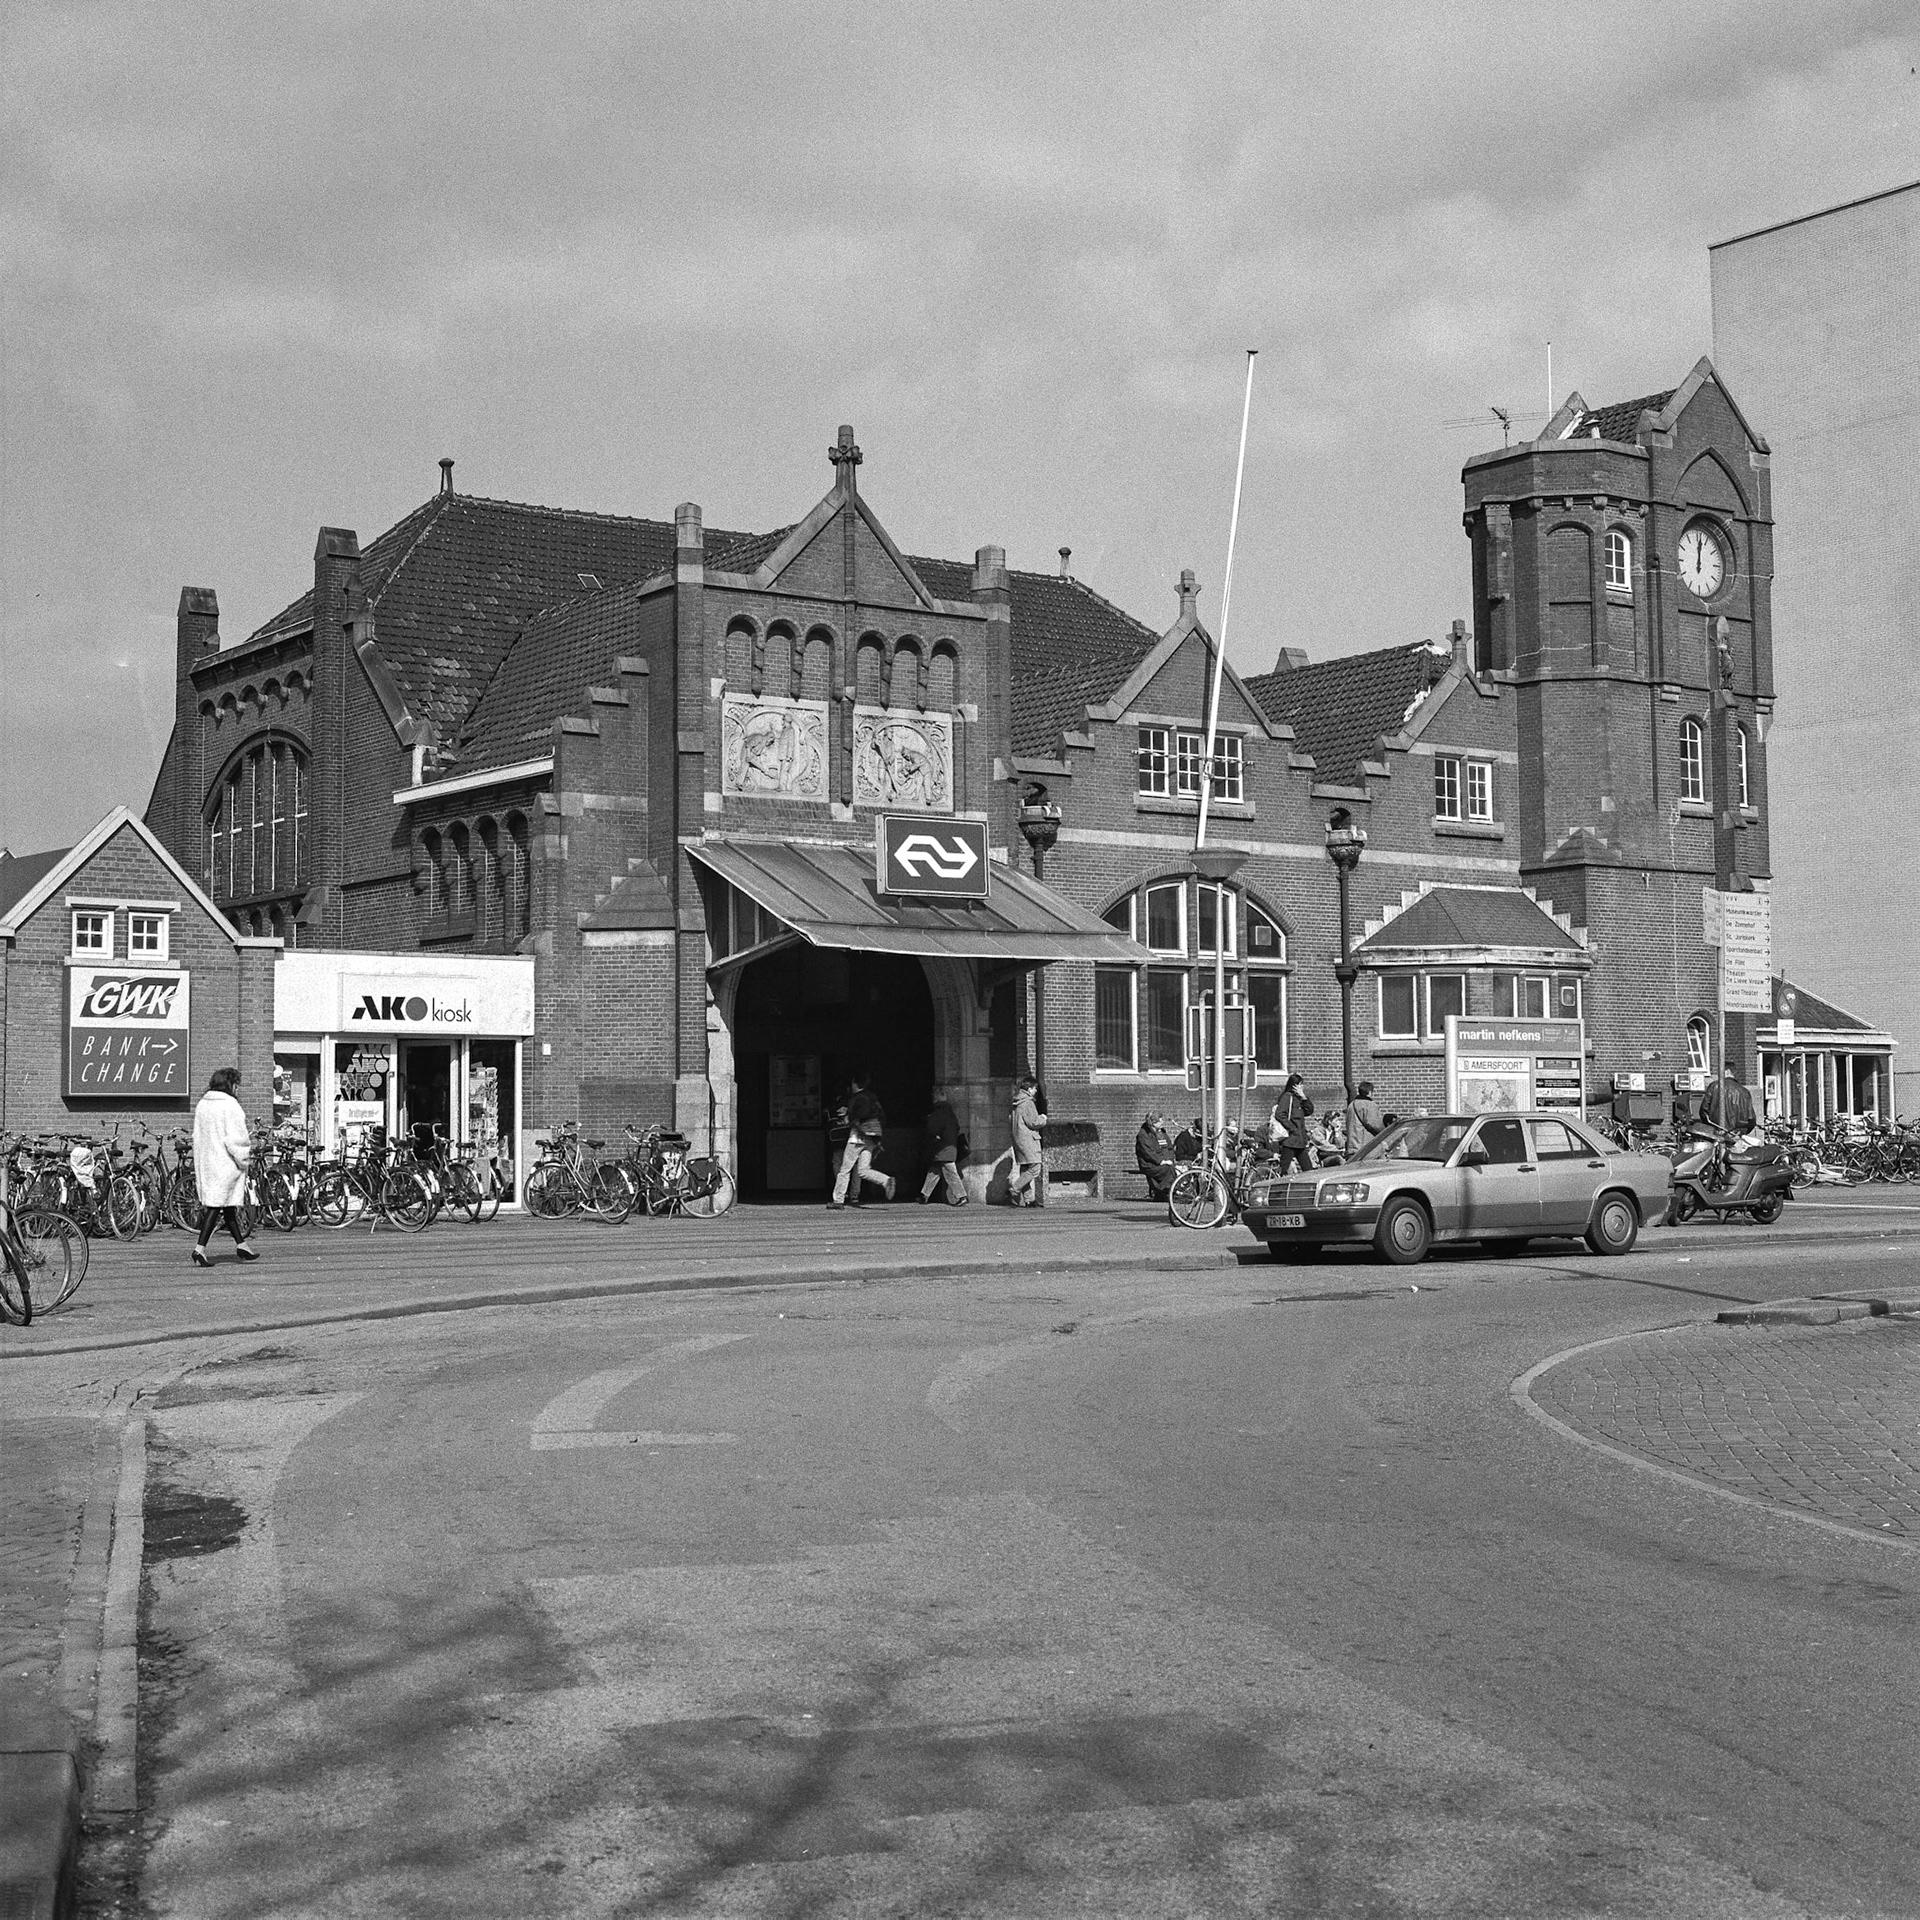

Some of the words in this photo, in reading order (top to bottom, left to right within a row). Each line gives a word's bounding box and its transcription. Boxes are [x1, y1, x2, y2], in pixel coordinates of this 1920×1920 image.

[1726, 969, 1746, 977] Theater
[1734, 977, 1747, 985] Lieve
[1749, 977, 1764, 985] Vrouw
[90, 981, 177, 1015] GWK
[1726, 988, 1740, 996] Grand
[352, 995, 428, 1022] AKO
[432, 997, 472, 1022] kiosk
[1459, 1028, 1496, 1041] martin
[1499, 1029, 1542, 1041] nefkens
[82, 1036, 152, 1056] BANK
[81, 1062, 177, 1083] CHANGE
[346, 1058, 389, 1073] AKO
[1471, 1061, 1524, 1070] AMERSFOORT
[340, 1072, 383, 1088] AKO
